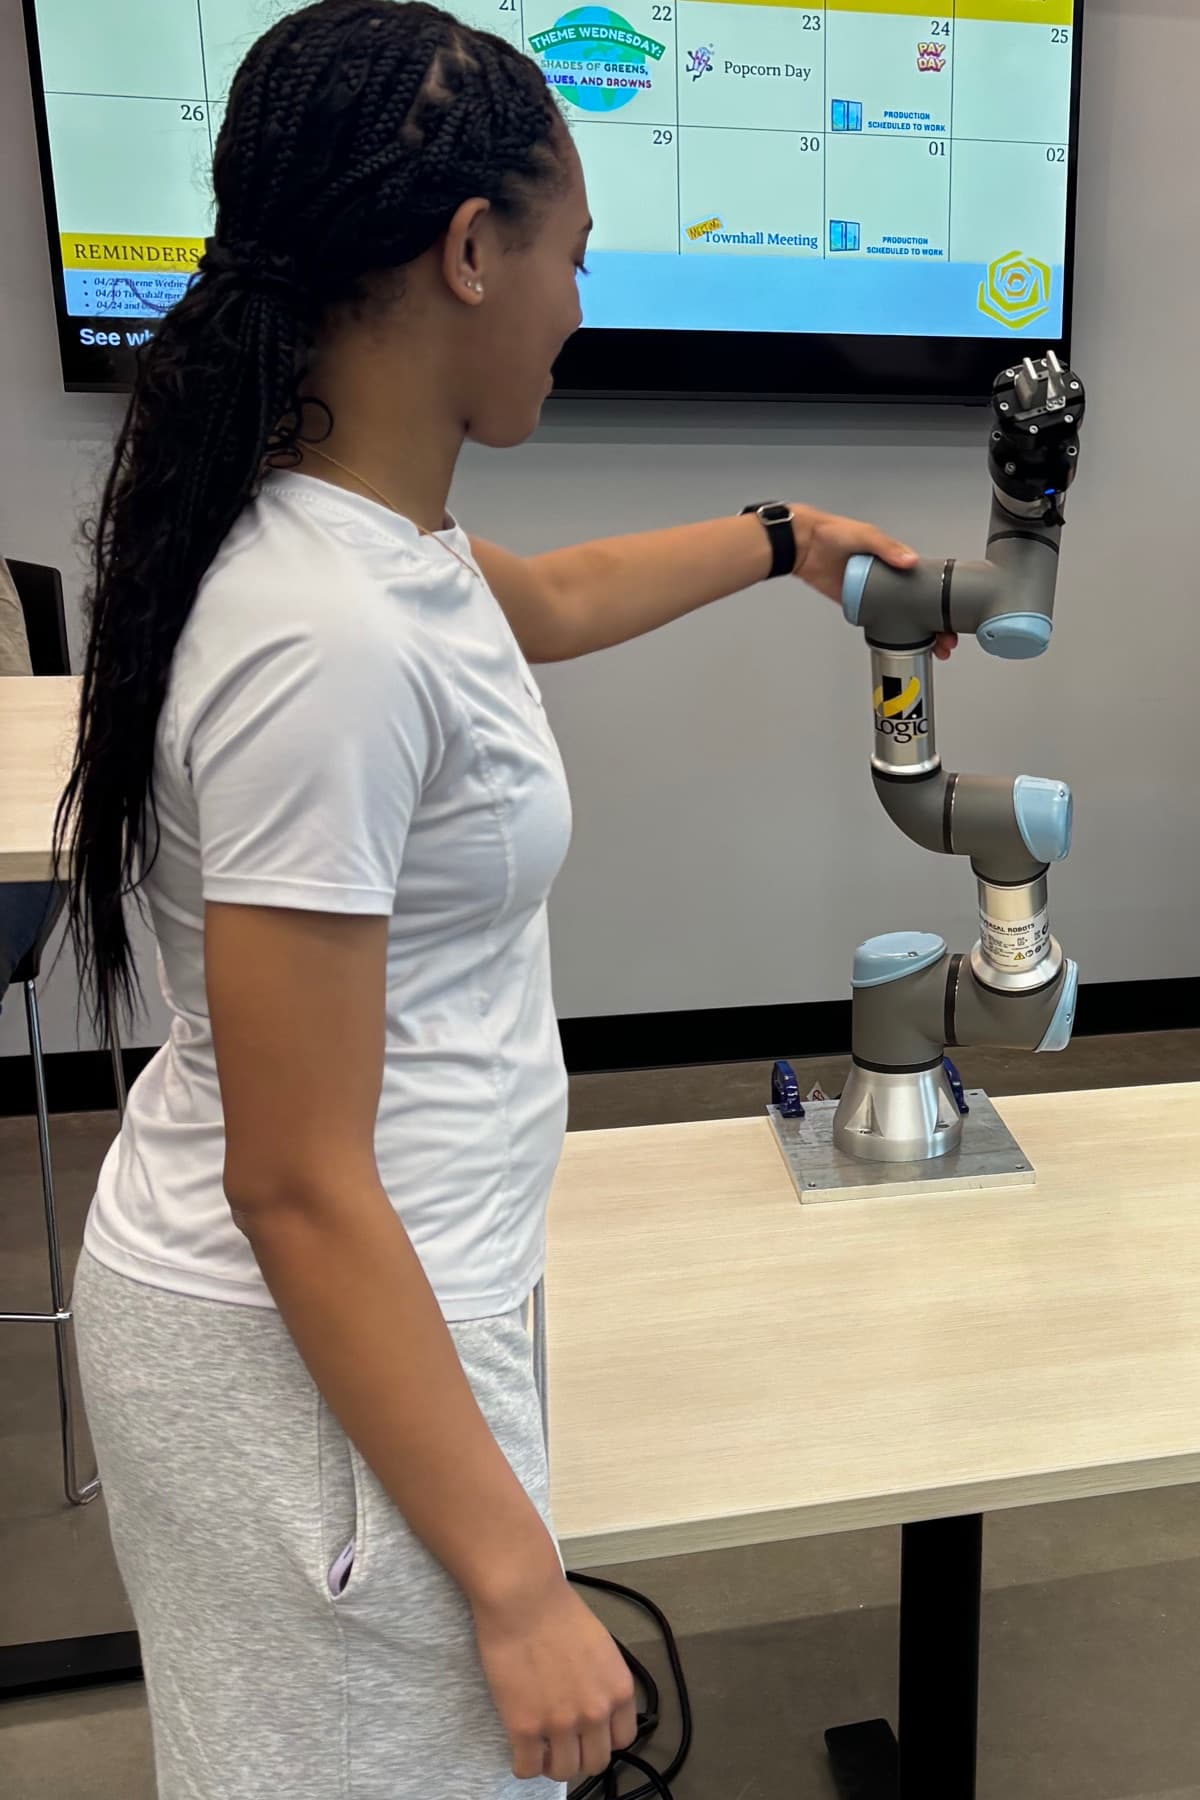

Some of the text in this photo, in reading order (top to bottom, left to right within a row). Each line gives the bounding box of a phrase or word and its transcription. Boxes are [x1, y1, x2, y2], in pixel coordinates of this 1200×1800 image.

[498, 0, 517, 11] 21
[651, 5, 673, 21] 22
[802, 15, 821, 31] 23
[931, 20, 950, 36] 24
[531, 27, 663, 57] THEME WEDNESDAY:
[1050, 28, 1069, 43] 25
[917, 41, 946, 57] PAY
[540, 60, 649, 75] SHADES OF GREENS,
[724, 61, 811, 81] Popcorn Day
[917, 57, 946, 72] DAY
[580, 78, 603, 87] AND
[606, 78, 652, 88] BROWNS
[180, 104, 205, 122] 26
[884, 110, 931, 120] PRODUCTION
[867, 121, 946, 132] SCHEDULED TO WORK
[652, 129, 673, 145] 29
[799, 136, 820, 152] 30
[928, 141, 945, 156] 01
[1046, 147, 1065, 162] 02
[703, 231, 819, 249] Townhall Meeting
[882, 235, 929, 245] PRODUCTION
[74, 243, 200, 263] REMINDERS
[866, 246, 944, 256] SCHEDULED TO WORK
[79, 328, 121, 346] See
